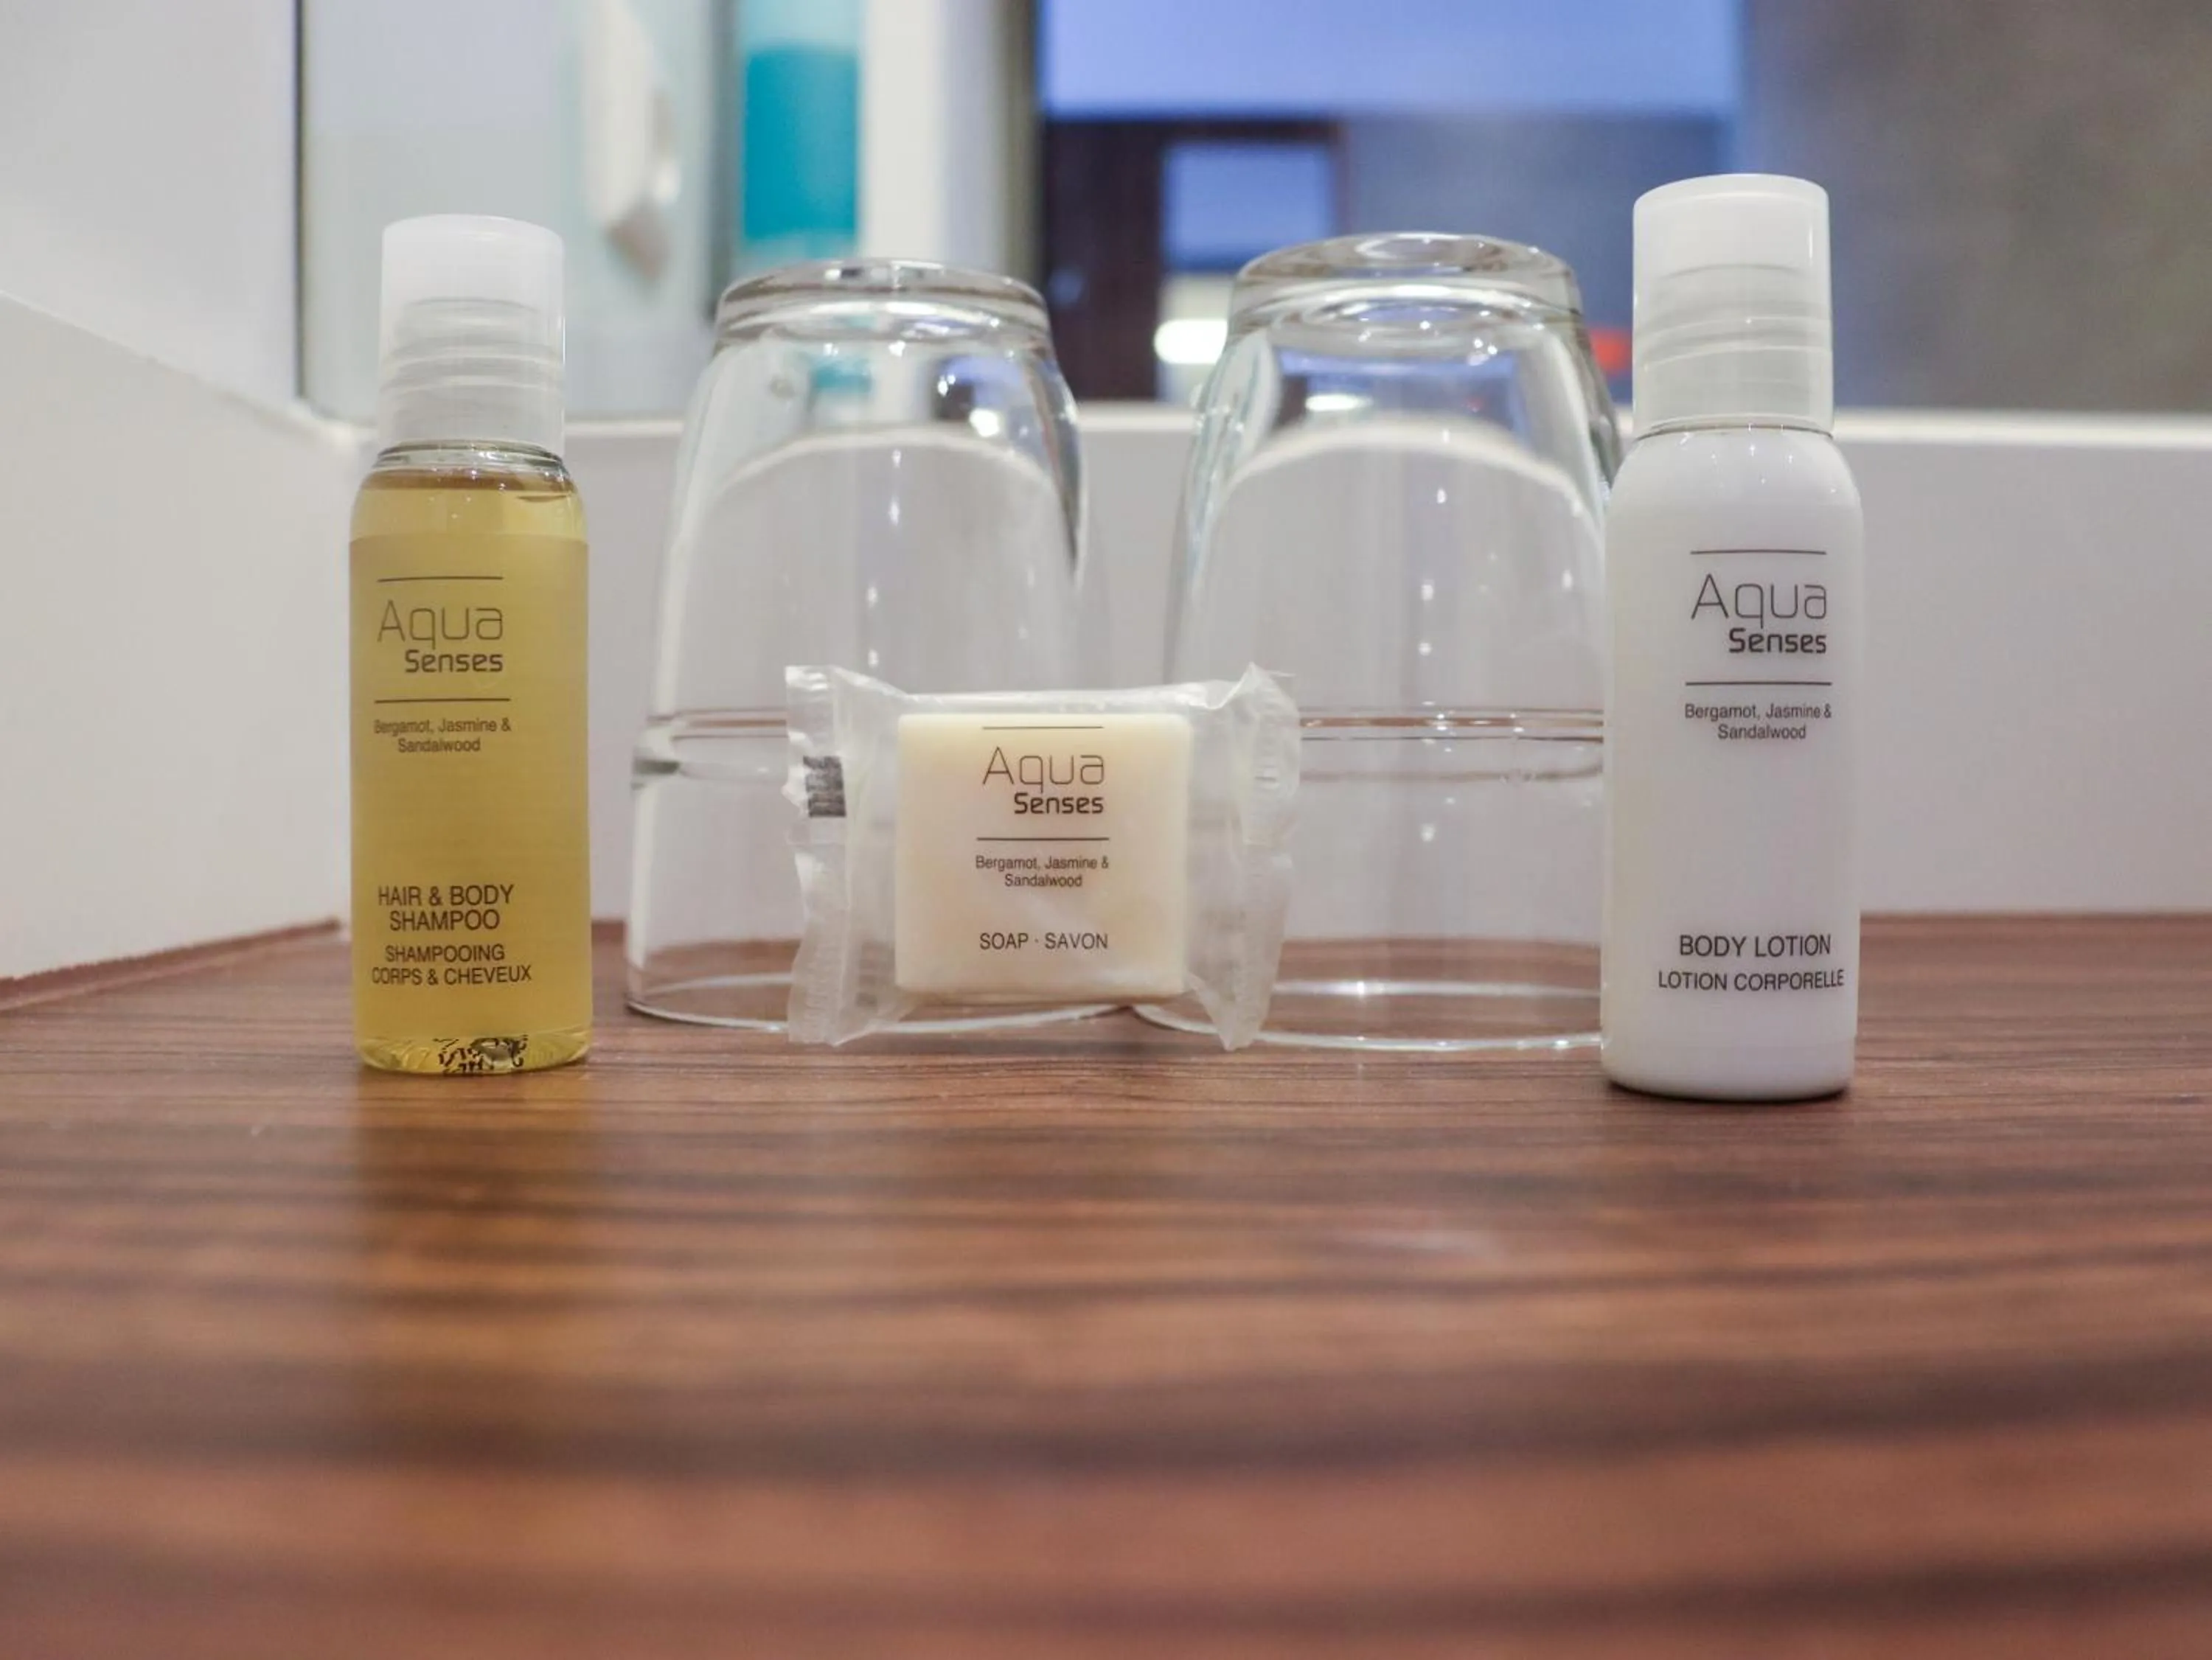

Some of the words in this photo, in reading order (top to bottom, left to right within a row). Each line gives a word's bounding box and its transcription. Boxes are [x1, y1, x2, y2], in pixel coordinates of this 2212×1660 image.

[1690, 572, 1829, 629] Aqua
[377, 599, 504, 651] Aqua
[1728, 627, 1828, 655] Senses
[404, 649, 504, 674] Senses
[1684, 703, 1761, 722] Bergamot,
[1766, 702, 1820, 719] Jasmine
[1824, 704, 1832, 719] &
[373, 719, 434, 736] Bergamot,
[437, 717, 498, 733] Jasmine
[501, 717, 512, 733] &
[1717, 724, 1807, 740] Sandalwood
[397, 738, 481, 754] Sandalwood
[982, 746, 1106, 794] Aqua
[1014, 792, 1105, 815] Senses
[975, 855, 1042, 872] Bergamot,
[1044, 854, 1099, 871] Jasmine
[1101, 855, 1110, 870] &
[1004, 873, 1083, 888] Sandalwood
[378, 885, 422, 907] HAIR
[428, 887, 442, 906] &
[450, 884, 515, 906] BODY
[389, 908, 501, 932] SHAMPOO
[385, 944, 506, 963] SHAMPOOING
[979, 932, 1030, 952] SOAP
[1044, 932, 1109, 951] SAVON
[1679, 935, 1747, 958] BODY
[1754, 933, 1832, 958] LOTION
[372, 966, 423, 986] CORPS
[428, 968, 439, 986] &
[444, 963, 533, 986] CHEVEUX
[1658, 969, 1728, 992] LOTION
[1733, 969, 1845, 993] CORPORELLE
